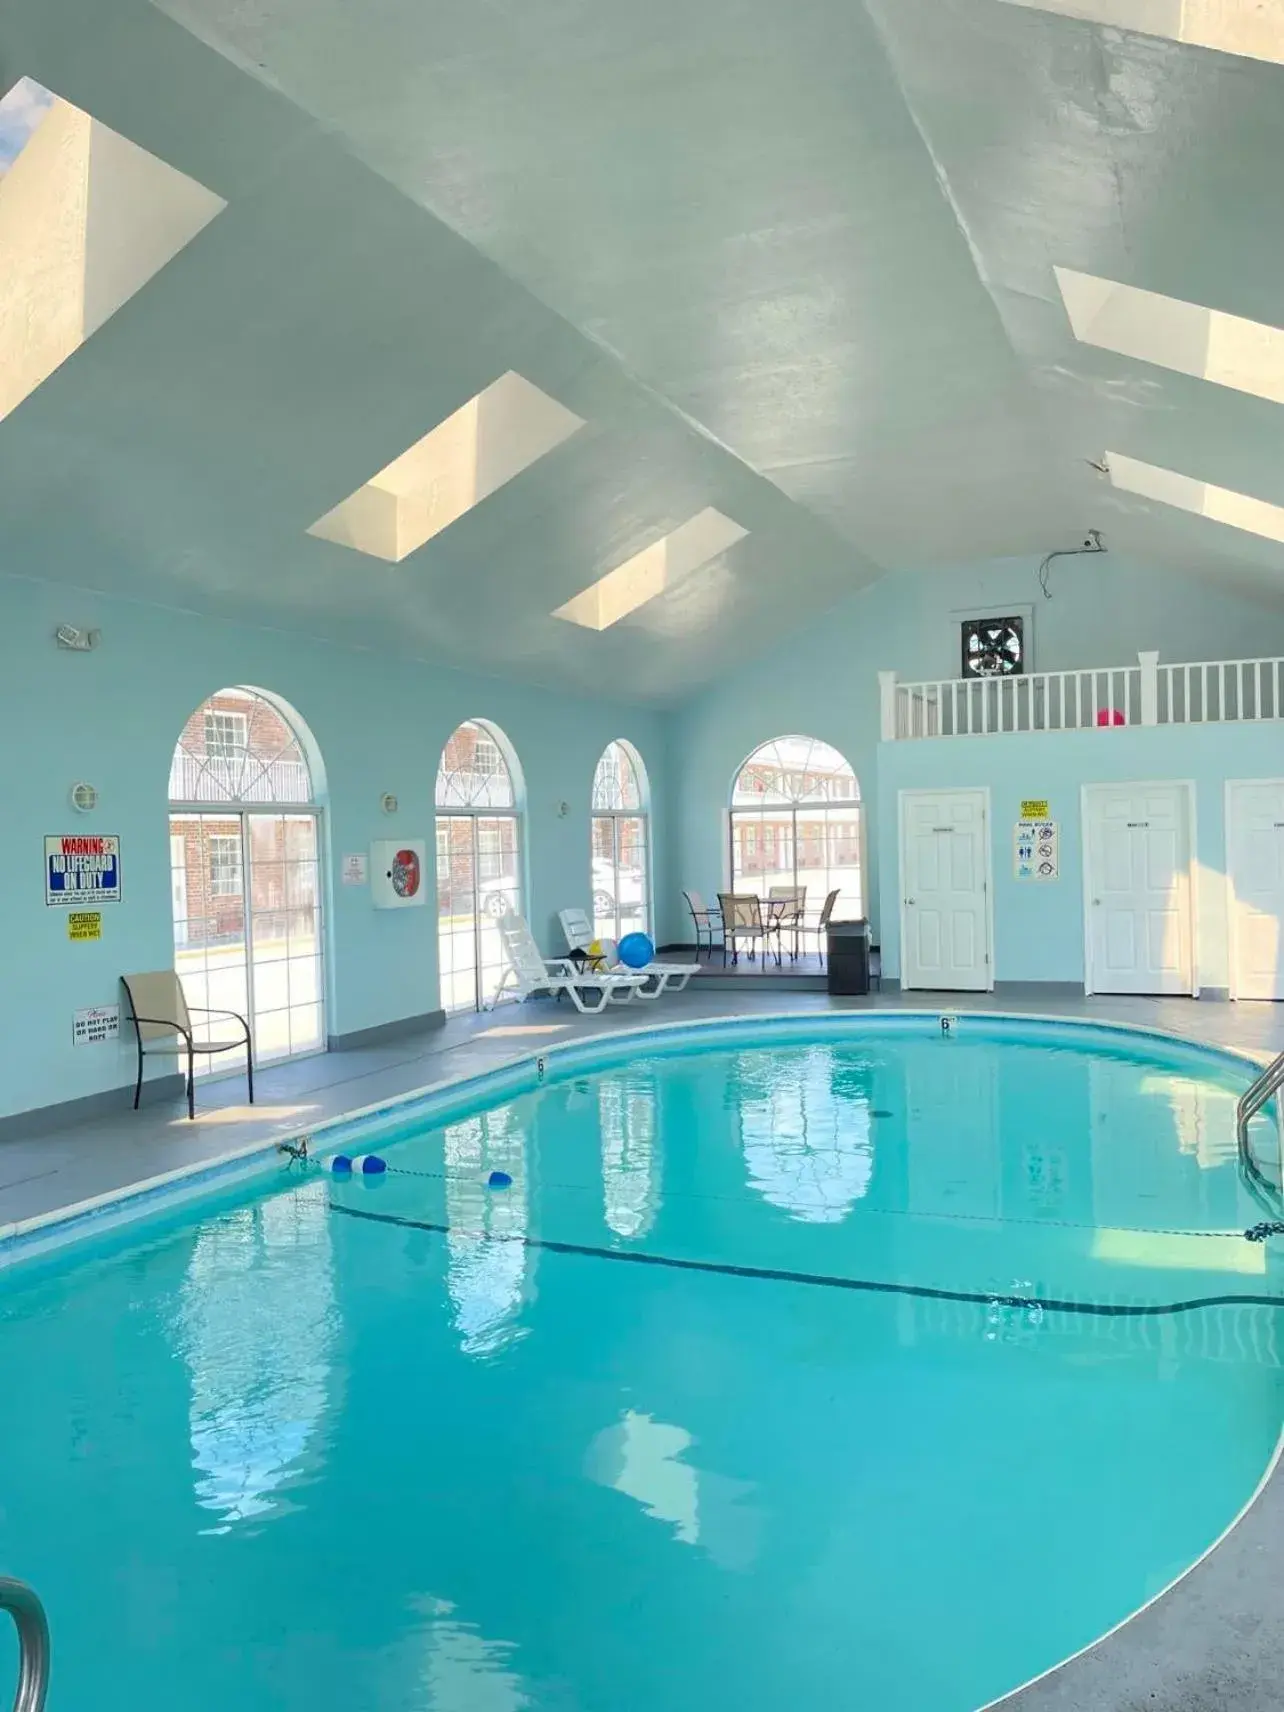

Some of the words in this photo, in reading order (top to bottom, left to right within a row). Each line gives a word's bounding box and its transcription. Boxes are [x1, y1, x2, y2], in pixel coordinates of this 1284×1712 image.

[62, 838, 104, 854] WARNING
[53, 855, 66, 873] NO
[67, 854, 113, 873] LIFEGUARD
[64, 871, 78, 890] ON
[80, 871, 103, 889] DUTY
[71, 913, 99, 922] CAUTION
[941, 1017, 950, 1030] 6
